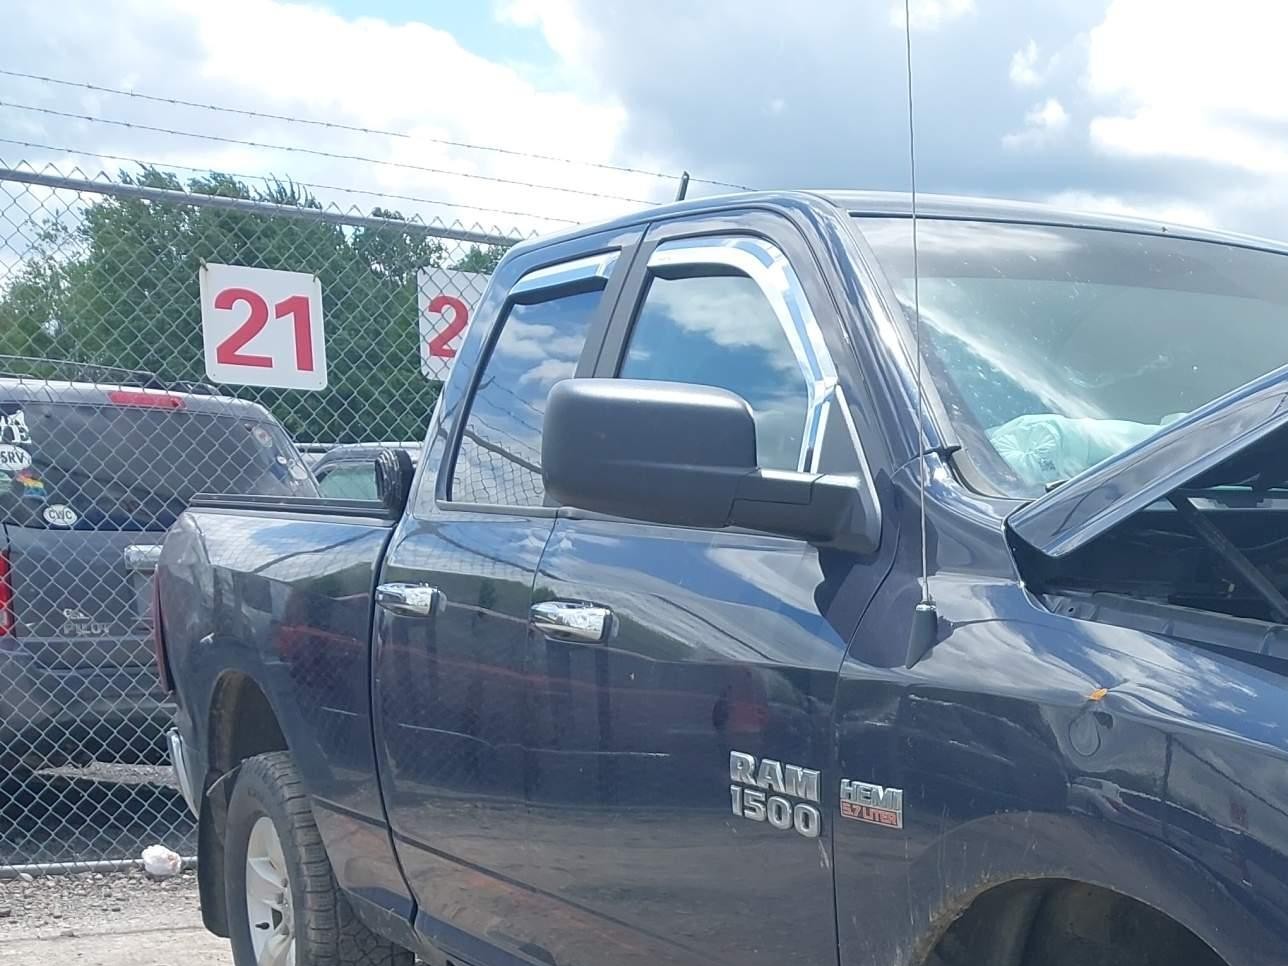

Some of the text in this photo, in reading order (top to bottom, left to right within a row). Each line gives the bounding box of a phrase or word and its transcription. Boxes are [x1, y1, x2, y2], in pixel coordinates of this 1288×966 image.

[214, 288, 314, 372] 21
[48, 509, 73, 520] CWC
[730, 750, 821, 801] RAM
[840, 779, 904, 810] HEMI
[730, 784, 821, 838] 1500
[842, 803, 898, 826] 5.7 LITER
